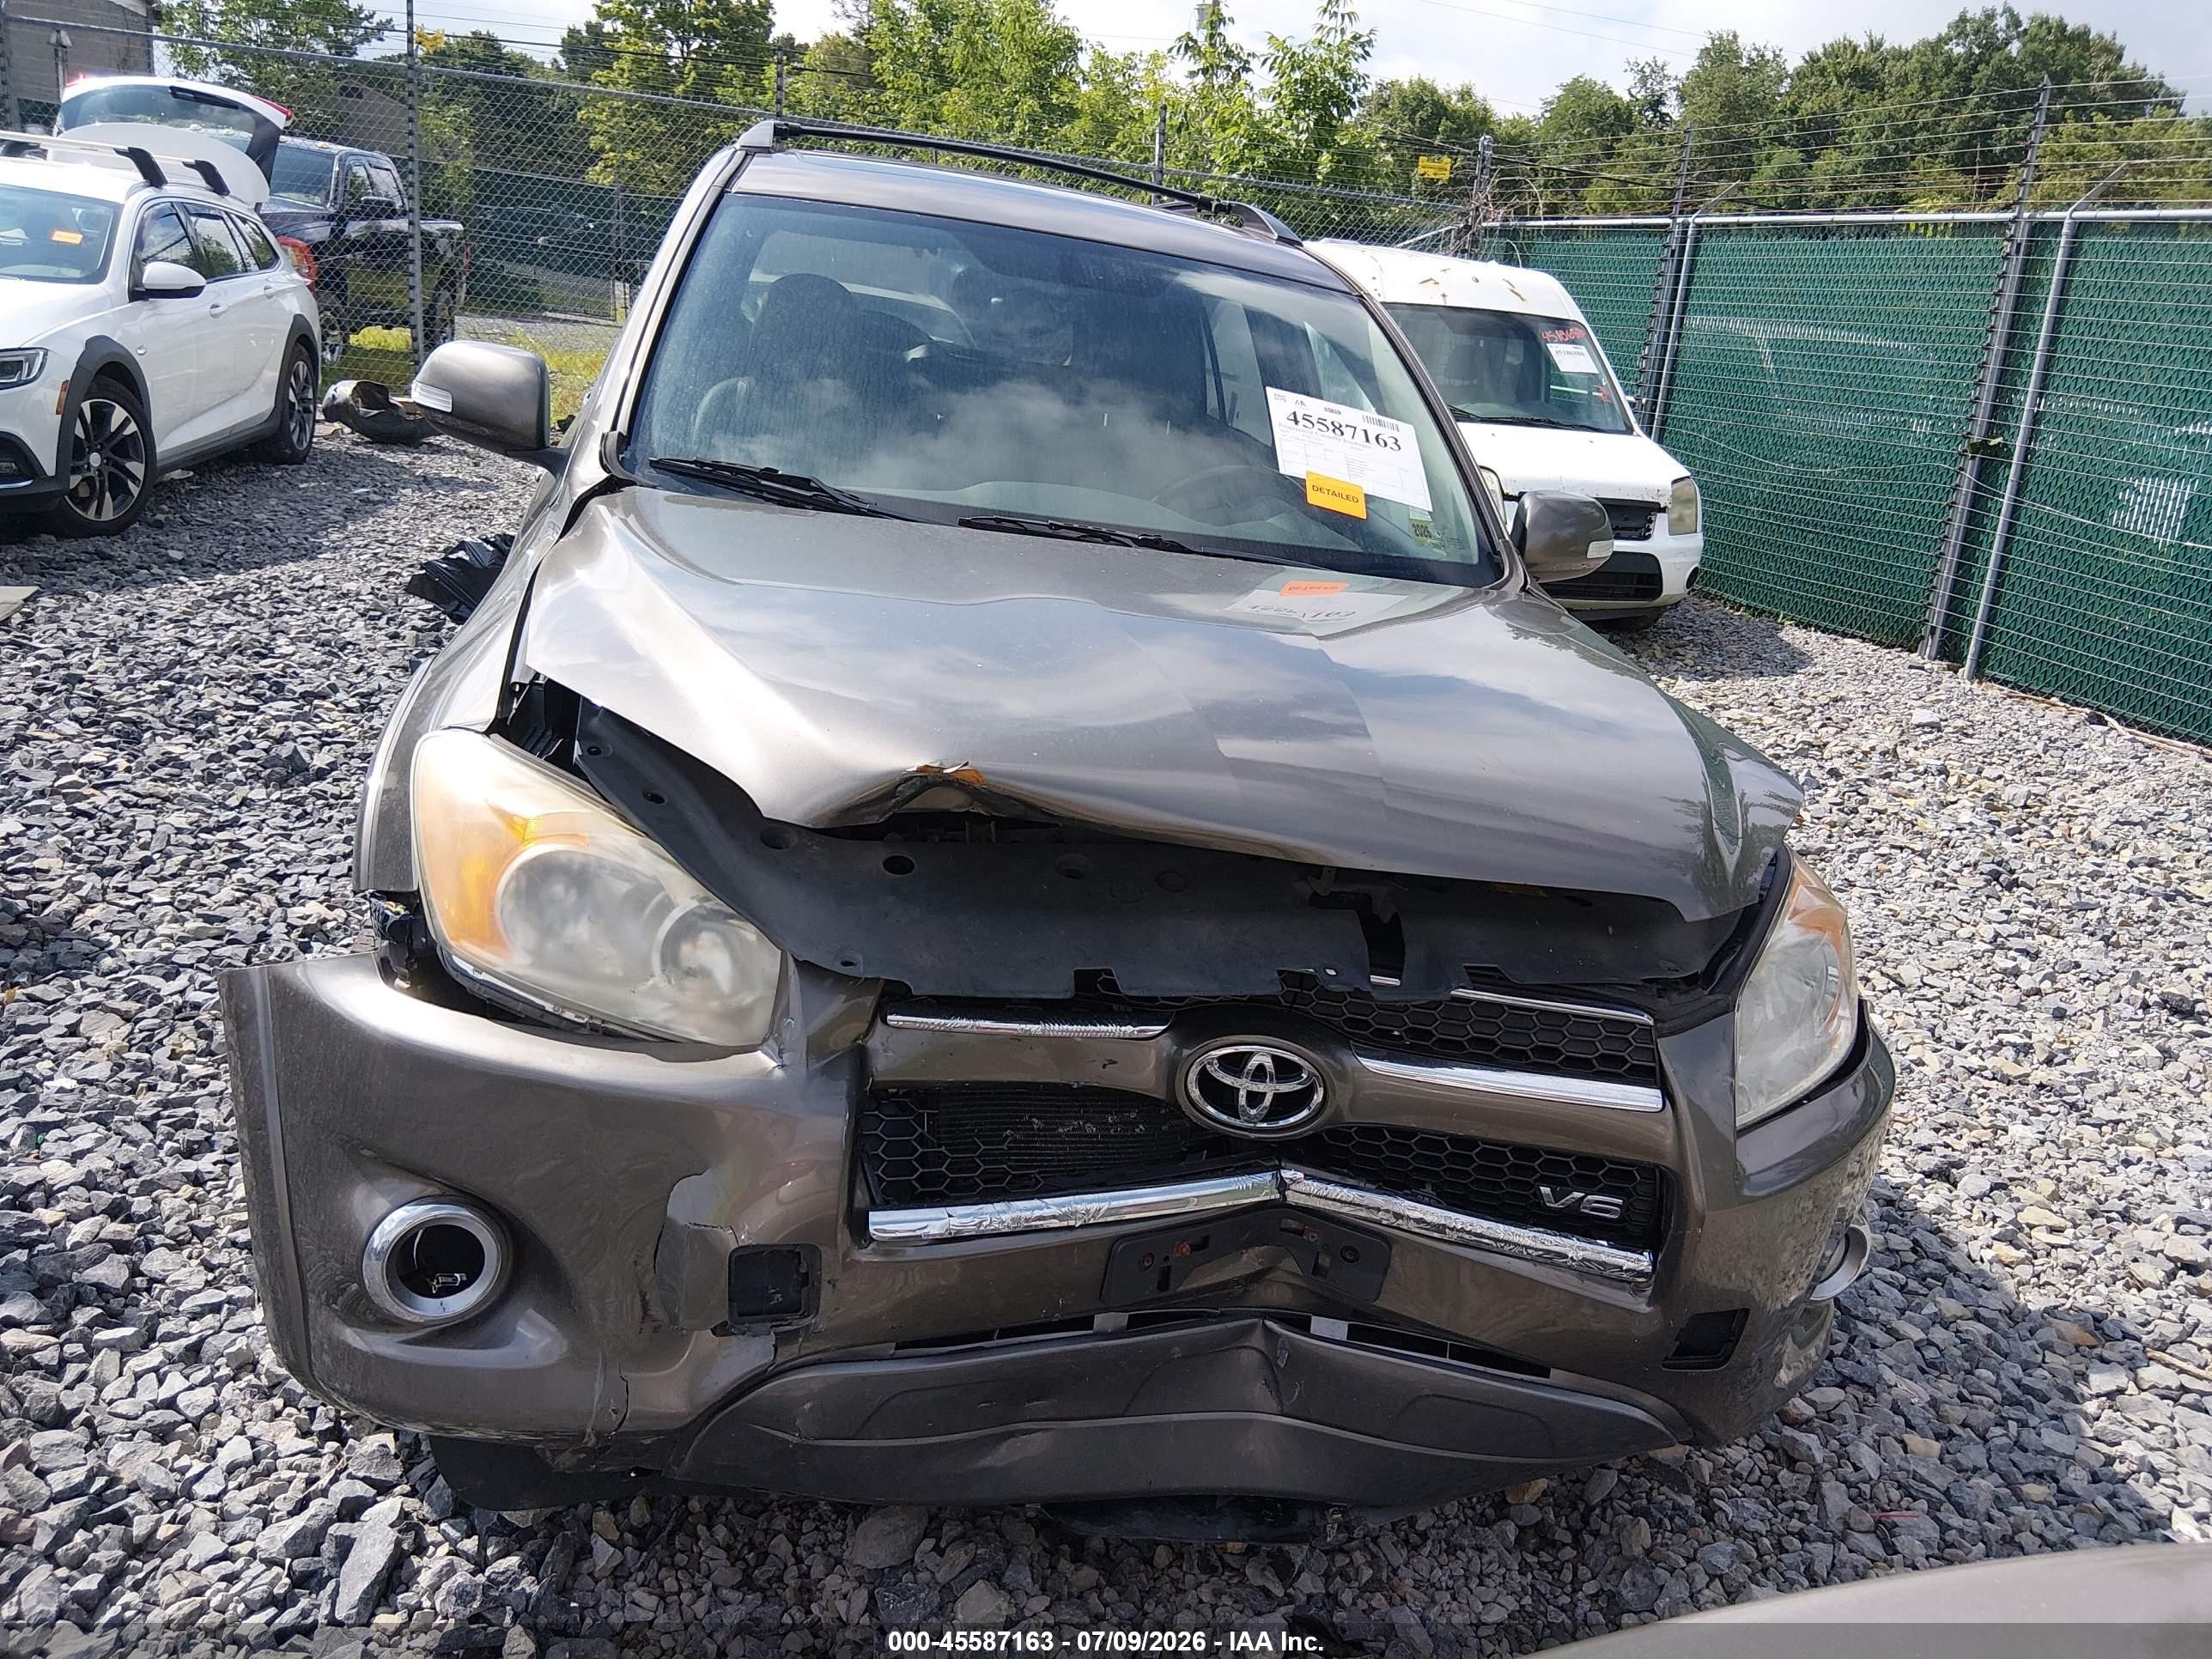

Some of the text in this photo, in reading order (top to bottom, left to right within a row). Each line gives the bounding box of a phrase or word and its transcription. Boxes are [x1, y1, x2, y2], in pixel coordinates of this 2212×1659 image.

[1286, 410, 1402, 452] 45587163
[1311, 484, 1359, 503] DETAILED
[1538, 1186, 1623, 1219] V6
